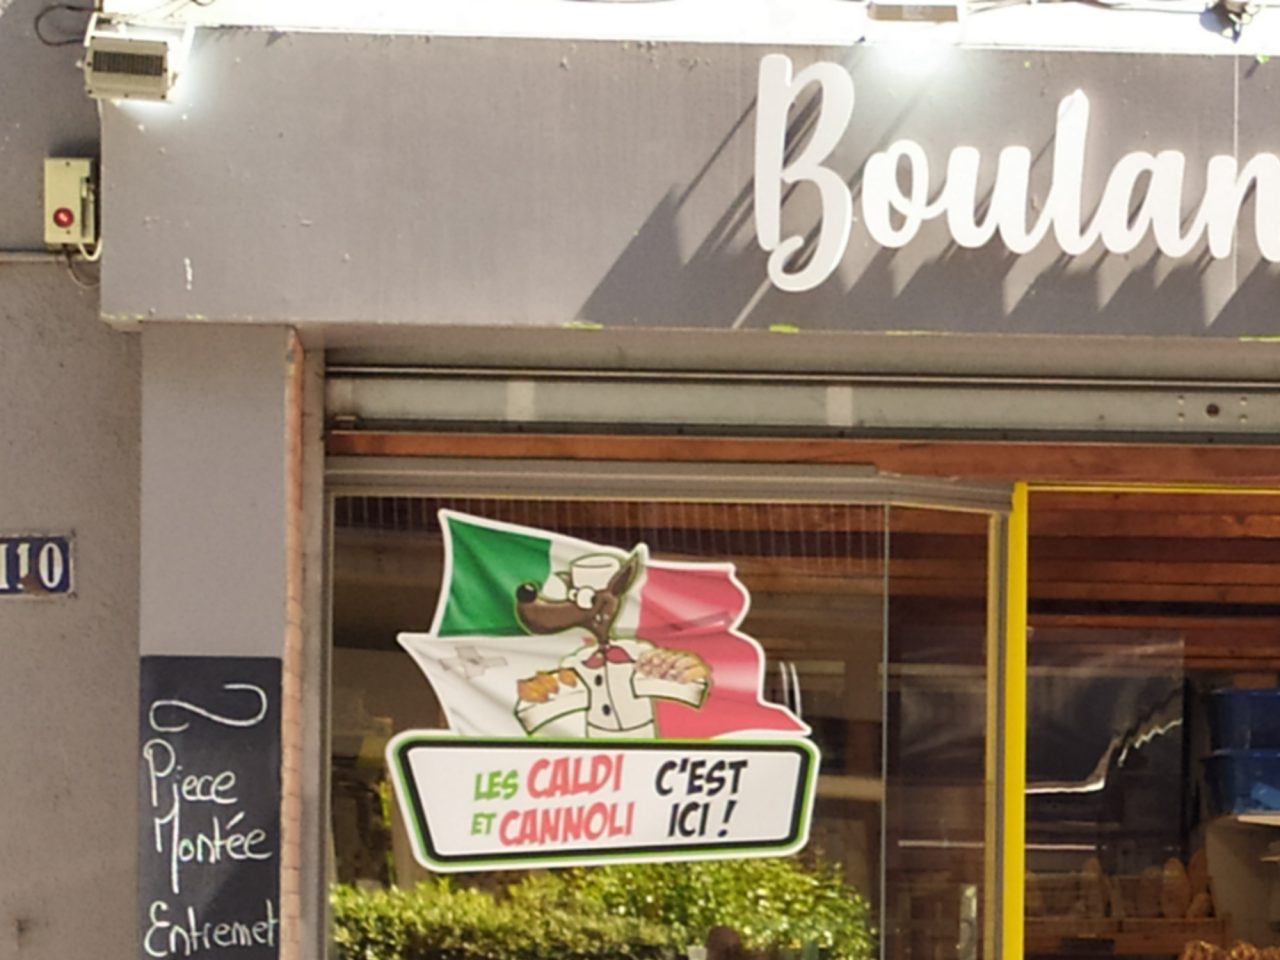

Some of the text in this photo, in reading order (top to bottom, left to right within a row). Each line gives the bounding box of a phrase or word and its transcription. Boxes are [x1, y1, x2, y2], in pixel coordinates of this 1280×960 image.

[473, 754, 625, 801] LES CALDI
[655, 758, 748, 796] C'EST
[470, 802, 635, 846] ET CANNOLI
[668, 802, 710, 837] ICI
[153, 795, 273, 894] Montée
[144, 900, 278, 957] Entremet
